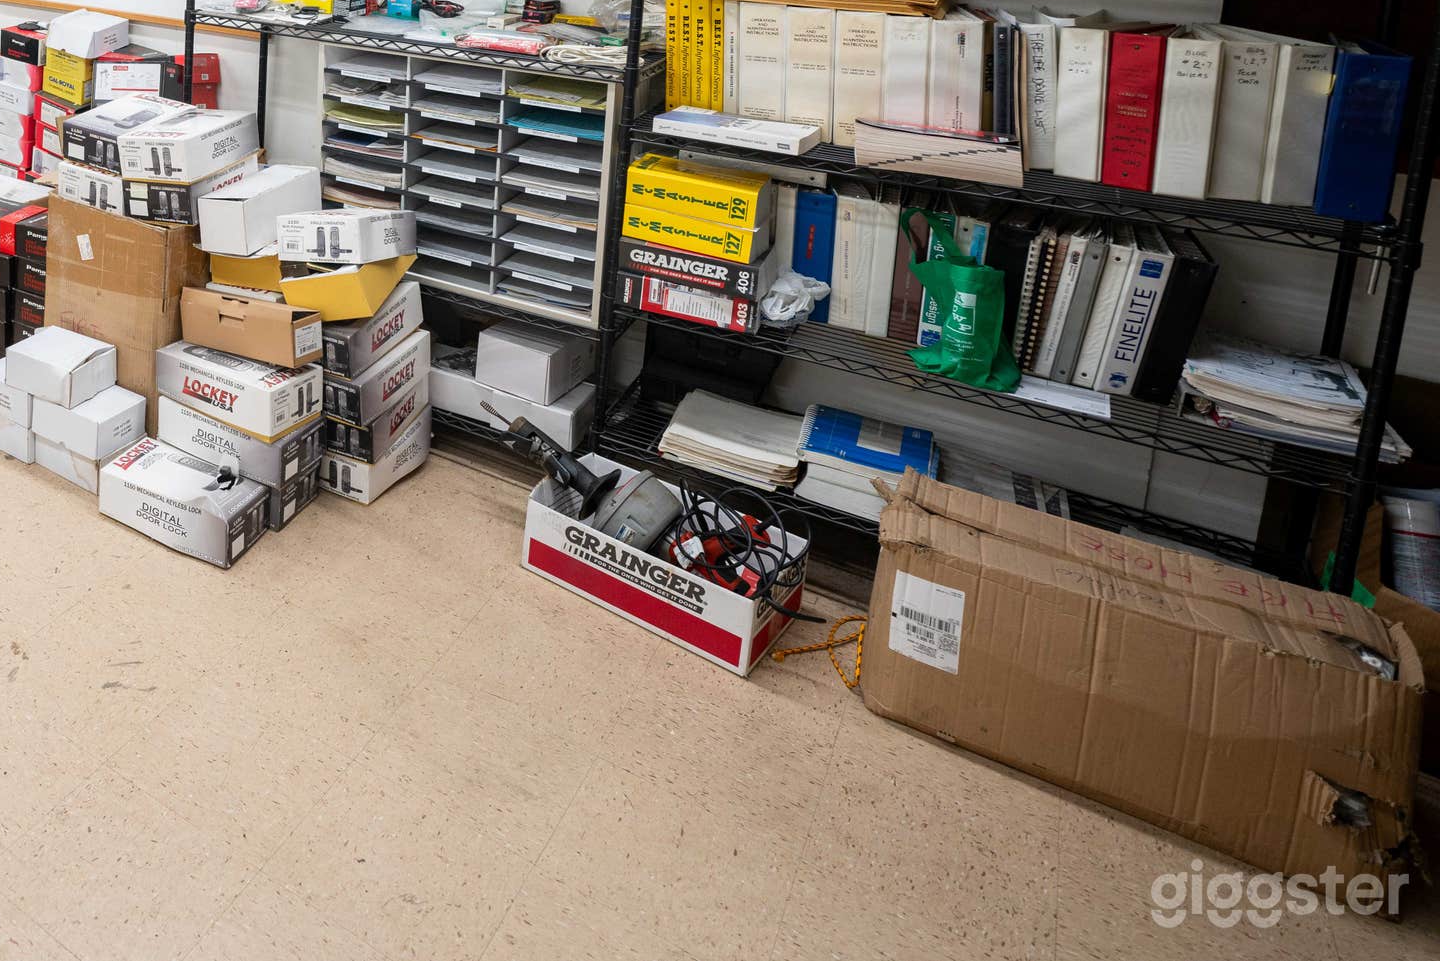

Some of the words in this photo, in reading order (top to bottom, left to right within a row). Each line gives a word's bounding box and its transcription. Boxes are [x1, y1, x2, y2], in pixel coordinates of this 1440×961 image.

[696, 19, 704, 48] B.E.S.T.
[48, 75, 76, 90] CAL-ROYAL
[695, 76, 703, 102] Services
[1032, 77, 1046, 105] DEVICE
[1032, 110, 1046, 135] LIST
[211, 148, 226, 159] DOOR
[226, 143, 241, 154] LOCK
[213, 135, 238, 153] DIGITAL
[730, 198, 746, 221] 129
[27, 231, 48, 241] Pame
[725, 232, 742, 256] 127
[26, 264, 46, 276] Pame
[629, 249, 729, 281] GRAINGER
[737, 271, 750, 295] 406
[736, 303, 748, 327] 403
[926, 296, 937, 324] esign
[371, 309, 405, 344] LOCKEY
[1115, 287, 1152, 362] FINELITE
[190, 364, 215, 381] MECHANICAL
[215, 375, 234, 387] KEYLESS
[234, 382, 246, 390] LOCK
[382, 357, 416, 392] LOCKEY
[183, 375, 239, 407] LOCKEY
[212, 401, 234, 413] USA
[389, 391, 417, 428] LOCKEY
[192, 411, 219, 428] MECHANICAL
[219, 424, 239, 437] KEYLESS
[239, 431, 252, 440] LOCK
[113, 438, 158, 468] LOCKEY
[191, 436, 216, 452] DOOR
[197, 428, 239, 452] DIGITAL
[395, 441, 419, 464] DIGITAL
[124, 481, 136, 491] 1150
[136, 485, 165, 503] MECHANICAL
[165, 496, 187, 511] KEYLESS
[188, 503, 202, 515] LOCK
[136, 509, 161, 526] DOOR
[162, 521, 188, 538] LOCK
[142, 502, 183, 528] DIGITAL
[565, 525, 707, 605] GRAINGER
[1072, 530, 1193, 584] HOSE
[594, 558, 607, 567] FOR
[608, 565, 620, 574] THE
[621, 570, 639, 583] ONES
[639, 580, 657, 591] WHO
[657, 589, 670, 597] GET
[678, 598, 698, 611] DONE
[1216, 579, 1347, 624] FIRE
